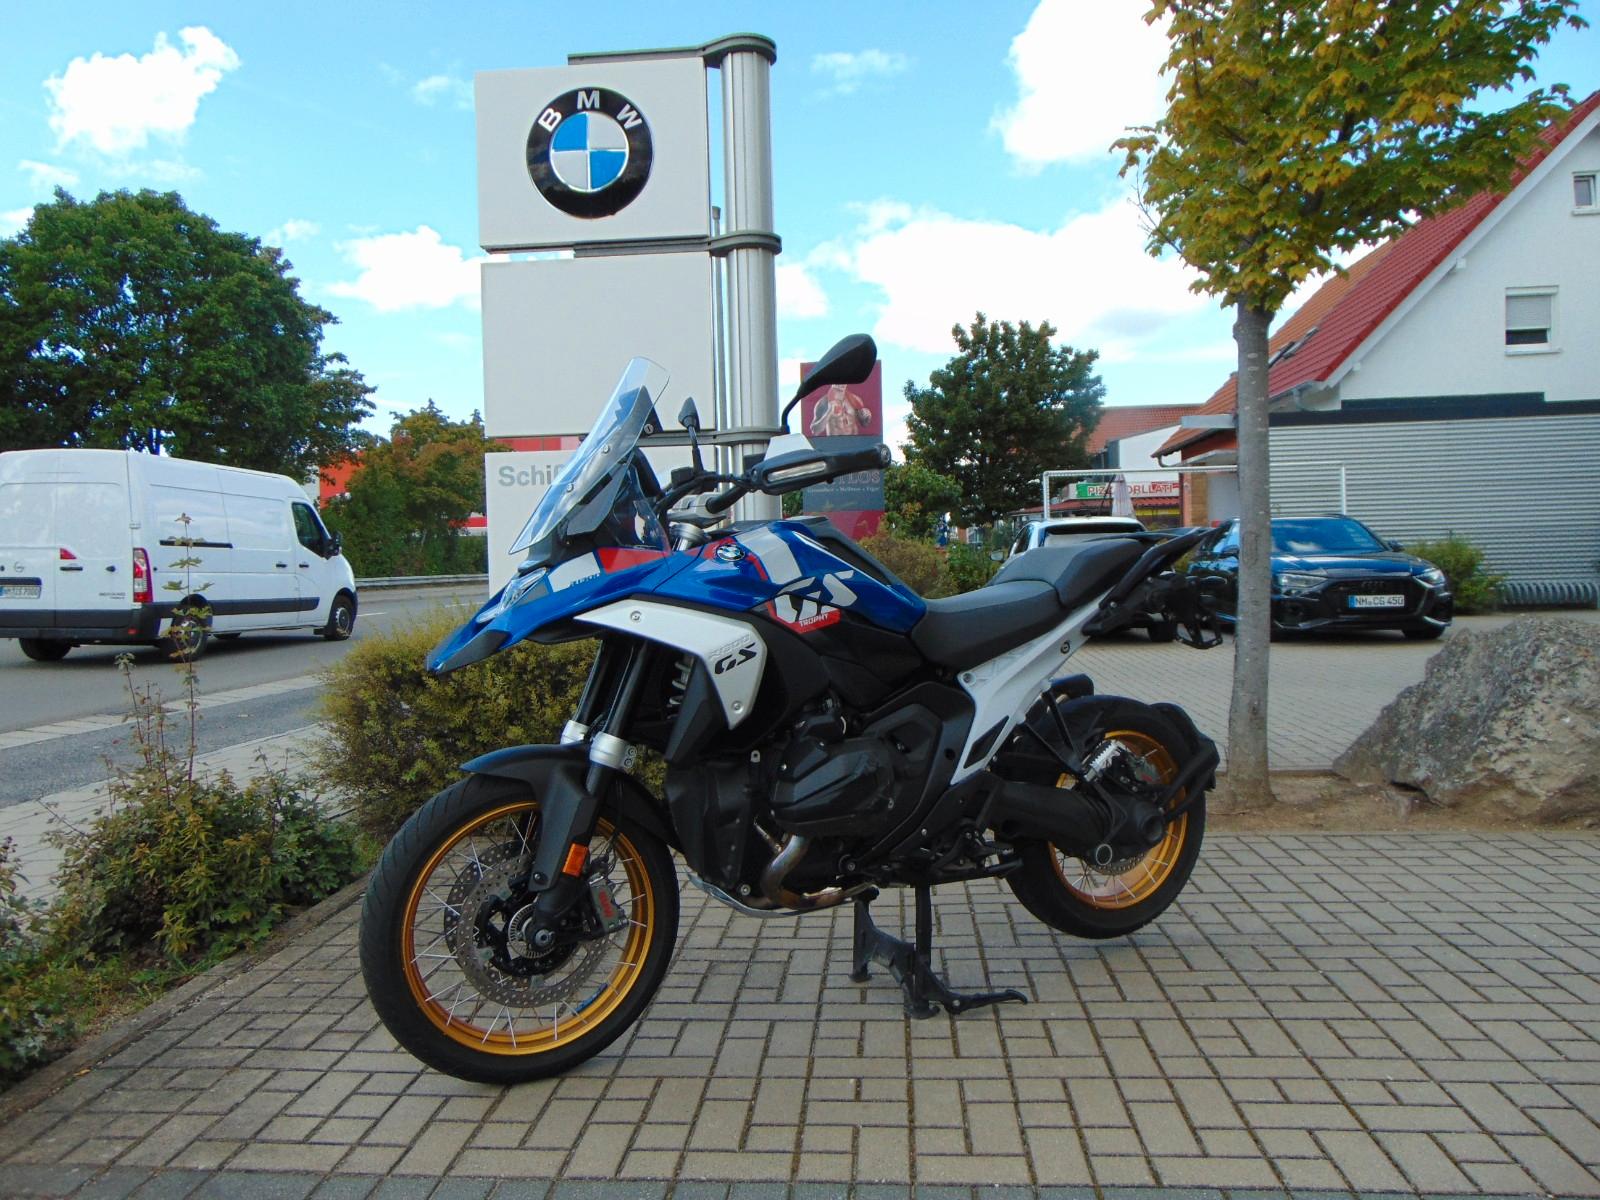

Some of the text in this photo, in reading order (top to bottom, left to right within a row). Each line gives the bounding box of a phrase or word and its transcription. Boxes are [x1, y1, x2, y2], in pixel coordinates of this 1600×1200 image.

[538, 90, 643, 132] BMW
[800, 613, 829, 627] TROPHY
[714, 642, 757, 675] GS
